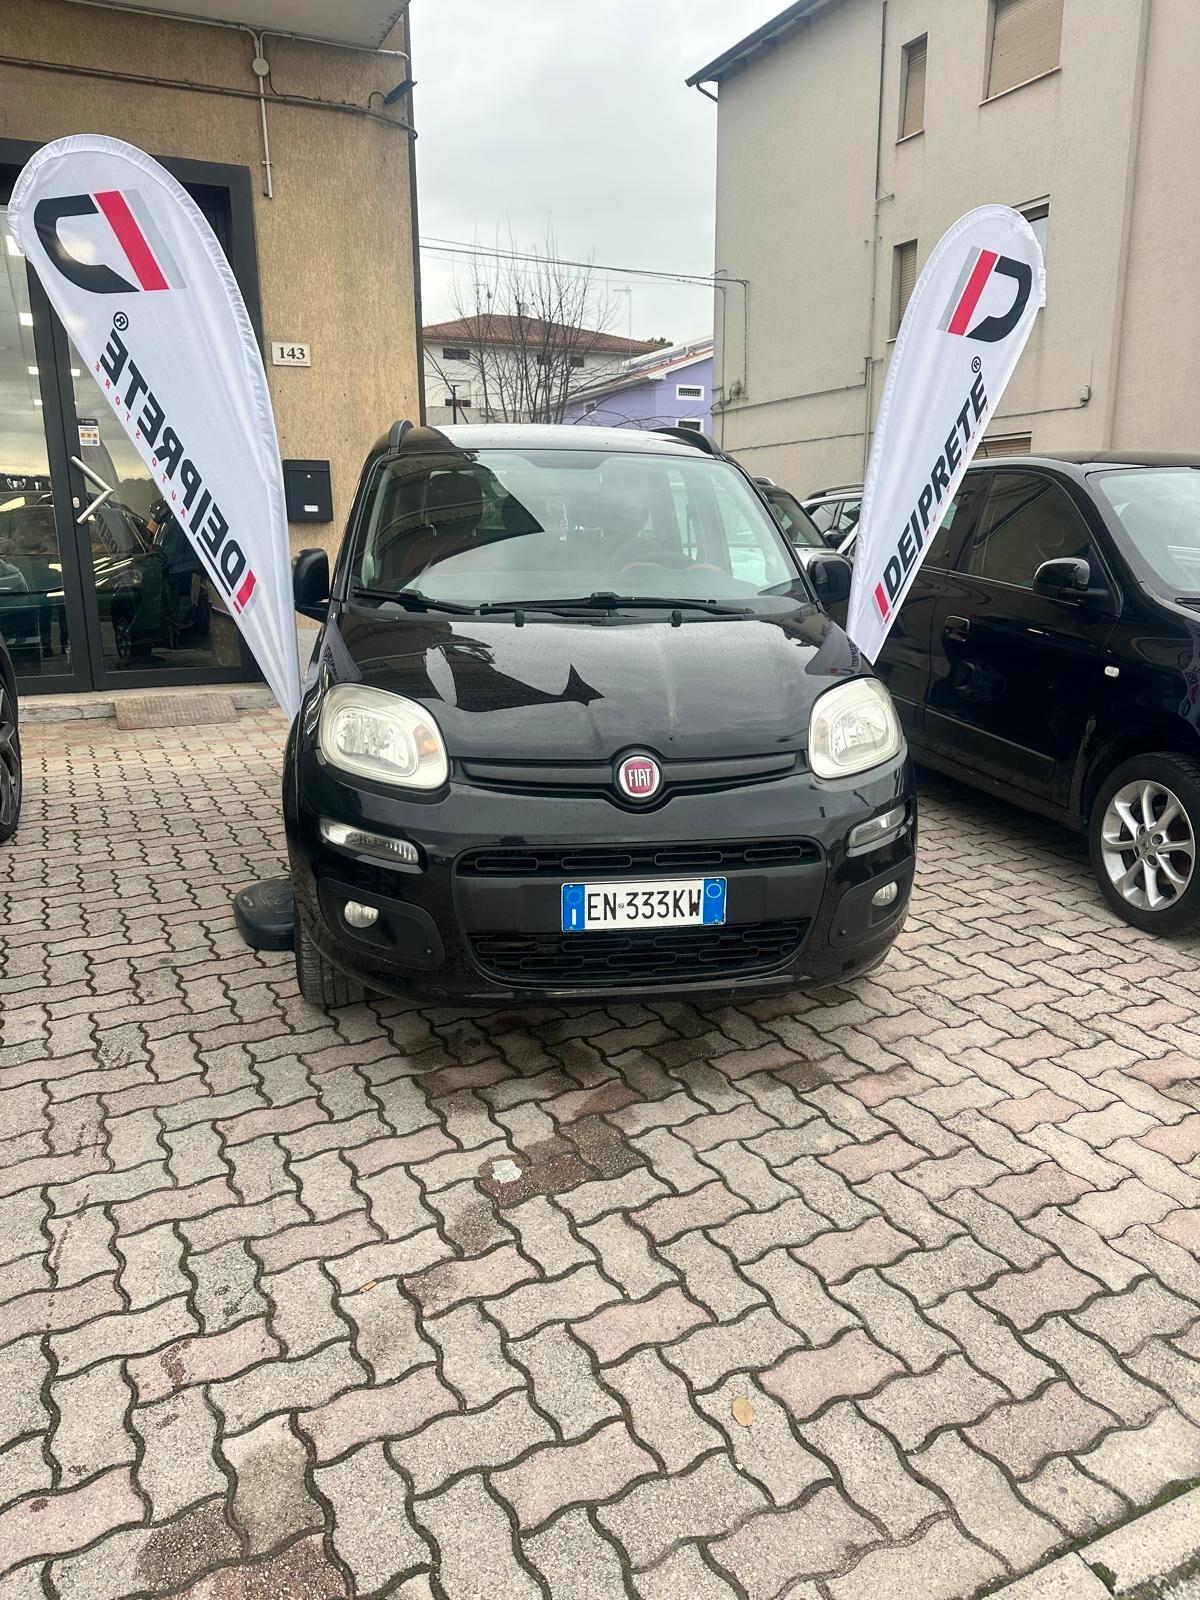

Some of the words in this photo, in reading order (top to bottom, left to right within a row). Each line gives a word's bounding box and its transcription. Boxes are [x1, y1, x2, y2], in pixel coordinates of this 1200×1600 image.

[279, 346, 306, 360] 143
[627, 768, 652, 787] FIAT
[587, 892, 617, 921] EN
[626, 888, 702, 920] 333KW
